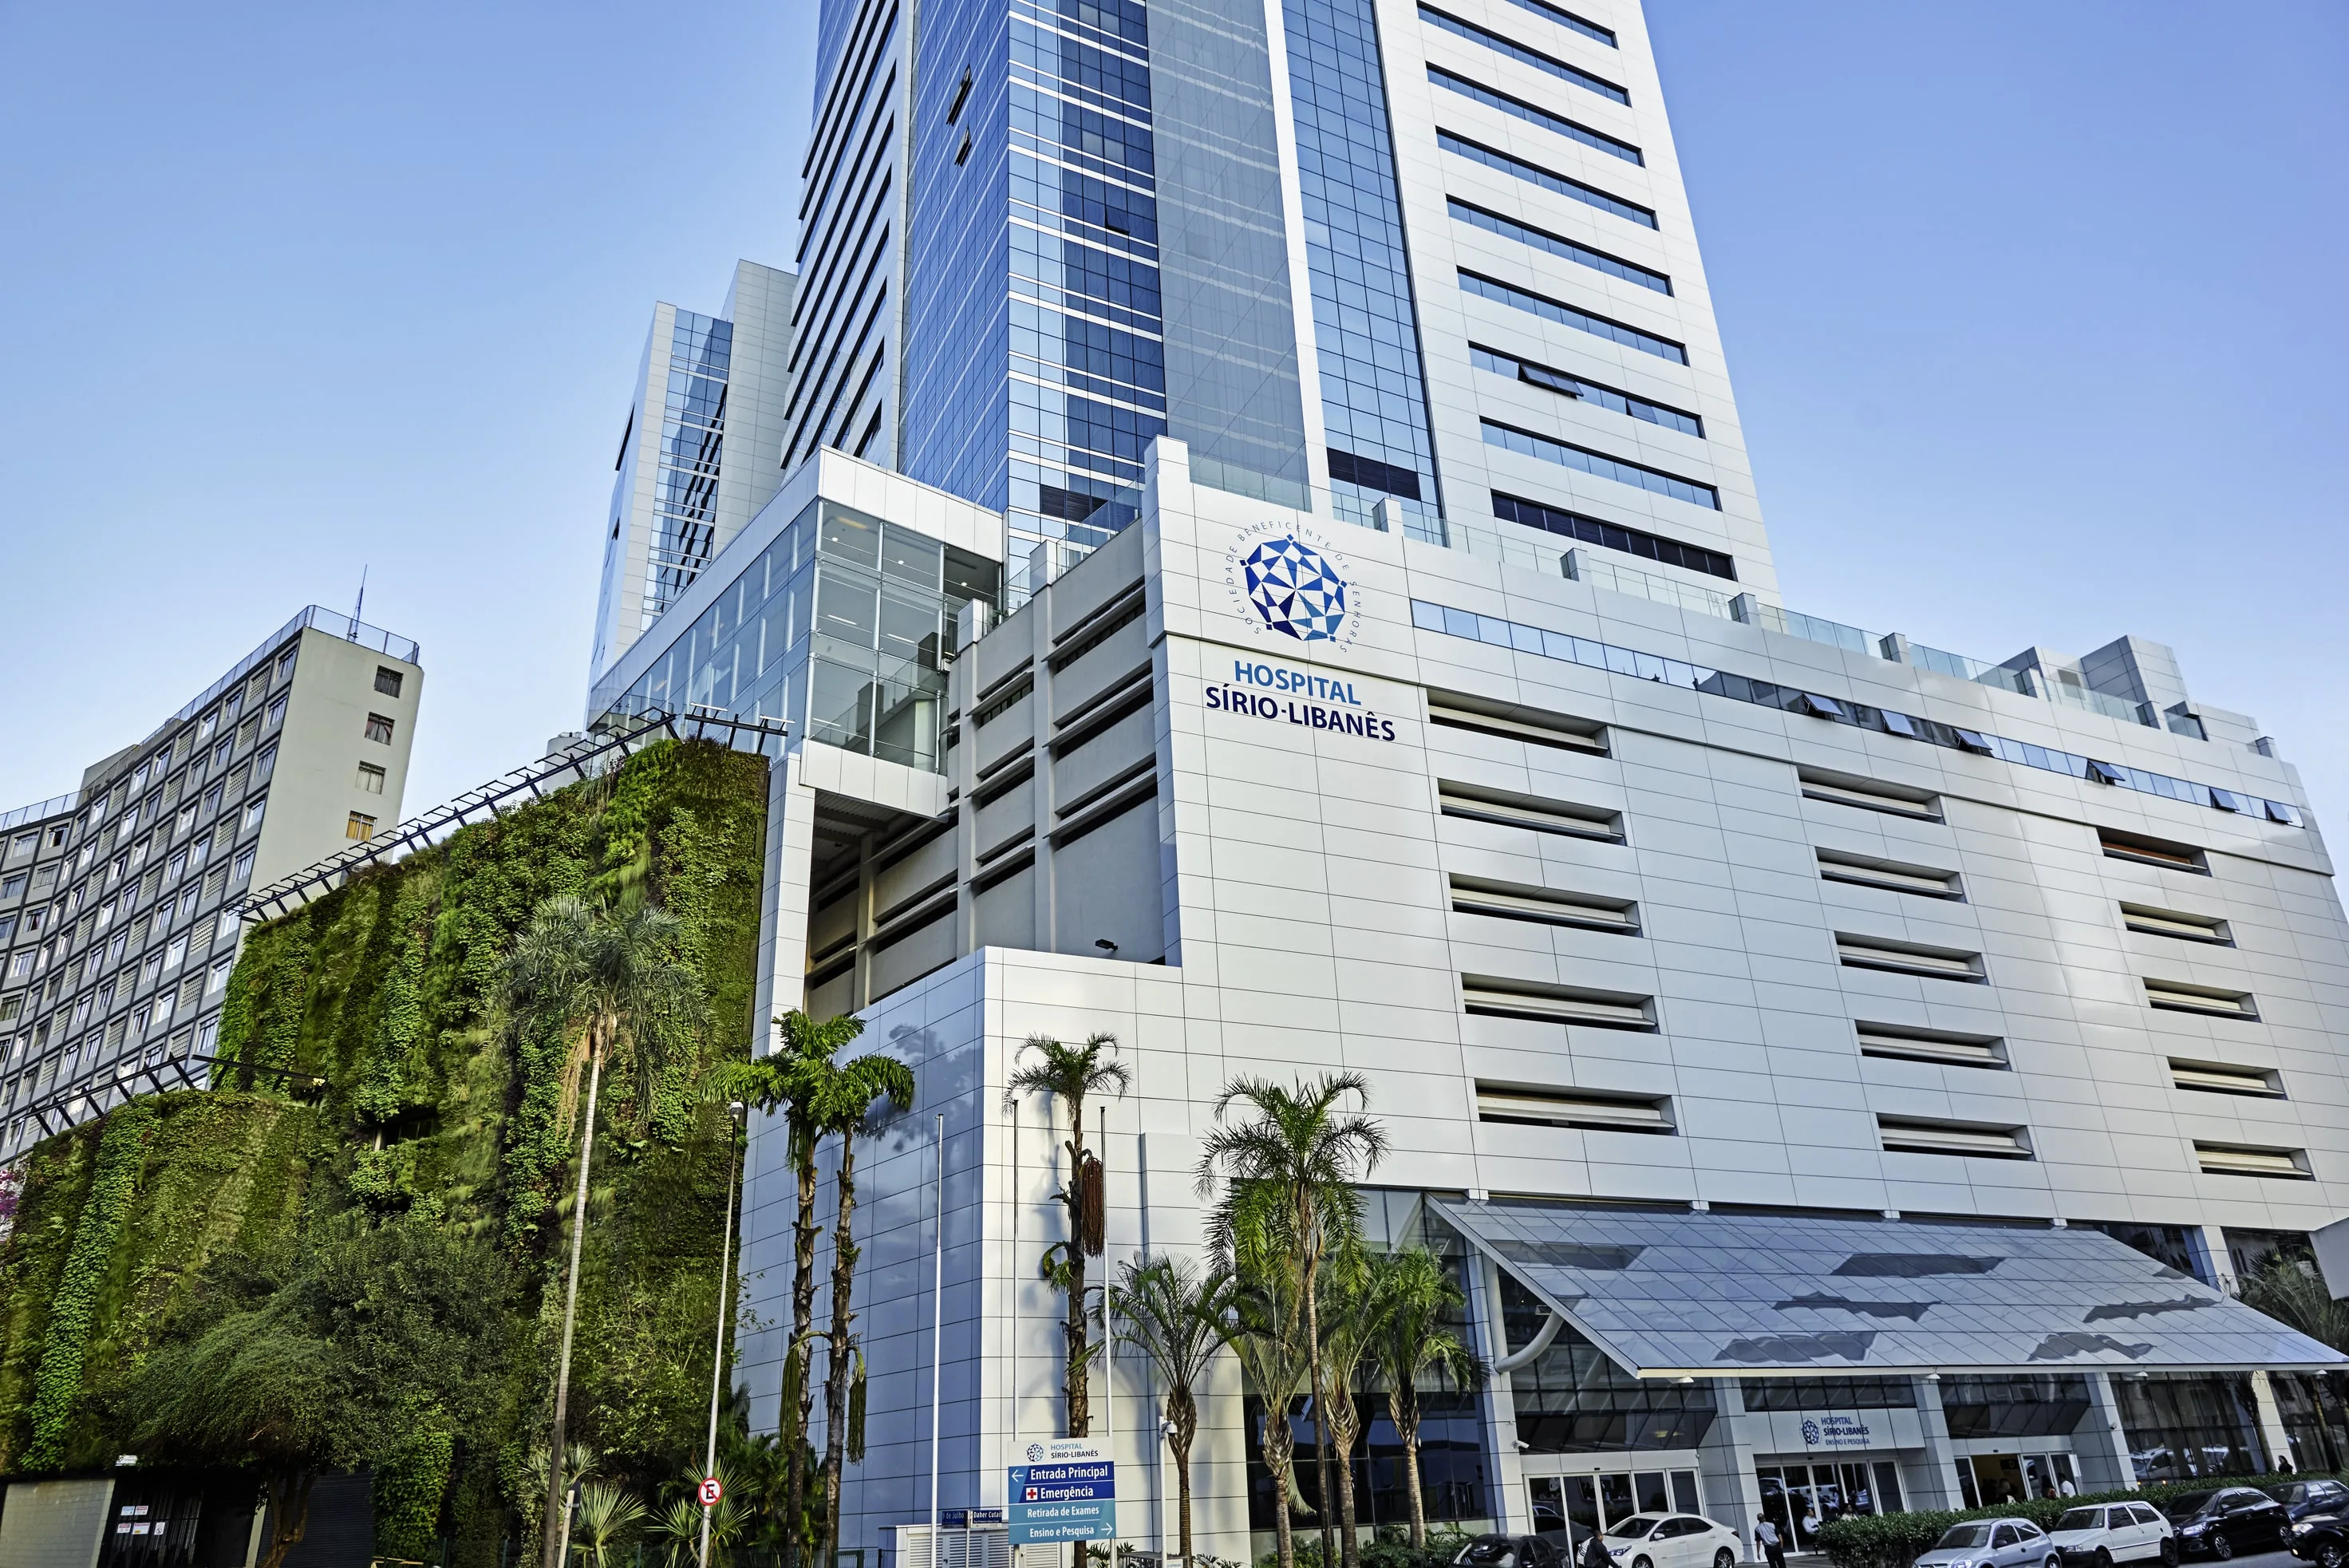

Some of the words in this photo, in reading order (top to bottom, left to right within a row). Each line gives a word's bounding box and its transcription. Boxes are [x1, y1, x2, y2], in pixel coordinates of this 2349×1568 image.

[1238, 521, 1331, 549] BENEFICENTE
[1335, 554, 1349, 571] DE
[1226, 546, 1261, 634] SOCIEDADE
[1340, 582, 1361, 653] SENHORAS
[1234, 660, 1361, 705] HOSPITAL
[1031, 1467, 1066, 1480] Entrada
[1068, 1465, 1108, 1479] Principal
[706, 1483, 715, 1499] E
[1040, 1487, 1093, 1500] Emergência
[952, 1511, 965, 1519] Julho
[1027, 1507, 1059, 1518] Retirada
[1060, 1507, 1070, 1516] de
[1072, 1507, 1099, 1515] Exames
[1029, 1528, 1054, 1538] Ensino
[1062, 1526, 1095, 1537] Pesquisa
